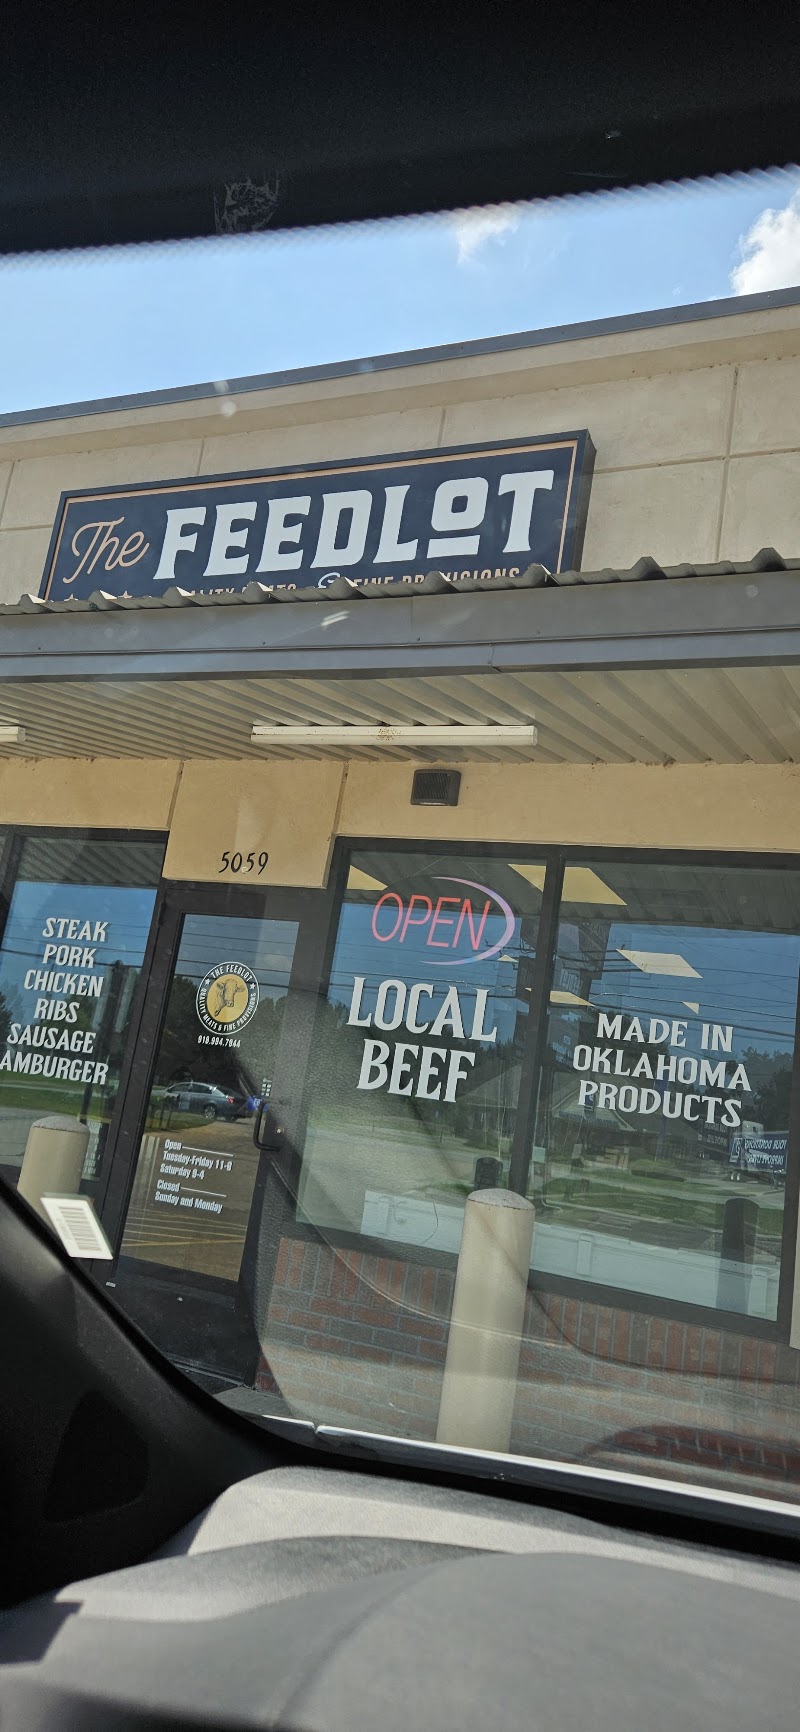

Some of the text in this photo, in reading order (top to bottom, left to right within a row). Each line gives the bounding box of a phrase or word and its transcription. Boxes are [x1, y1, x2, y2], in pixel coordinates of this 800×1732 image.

[62, 470, 554, 584] The FEEDLOT
[218, 851, 269, 875] 5059
[42, 917, 109, 942] STEAK
[371, 892, 491, 950] OPEN
[42, 944, 97, 968] PORK
[24, 969, 104, 997] CHICKEN
[210, 964, 253, 982] THE FEEDLOT
[34, 998, 80, 1023] RIBS
[346, 976, 498, 1042] LOCAL
[203, 1013, 218, 1030] MEATS
[223, 1023, 236, 1032] FINE
[596, 1013, 734, 1052] MADE IN
[7, 1023, 96, 1053] SAUSAGE
[357, 1039, 476, 1103] BEEF
[573, 1044, 752, 1091] OKLAHOMA
[578, 1079, 742, 1127] PRODUCTS
[164, 1138, 182, 1150] Open
[160, 1163, 205, 1180] Saturday 9-4
[163, 1150, 214, 1169] Tuesday-Friday
[157, 1179, 180, 1192] Closed
[155, 1191, 223, 1214] Sunday and Monday
